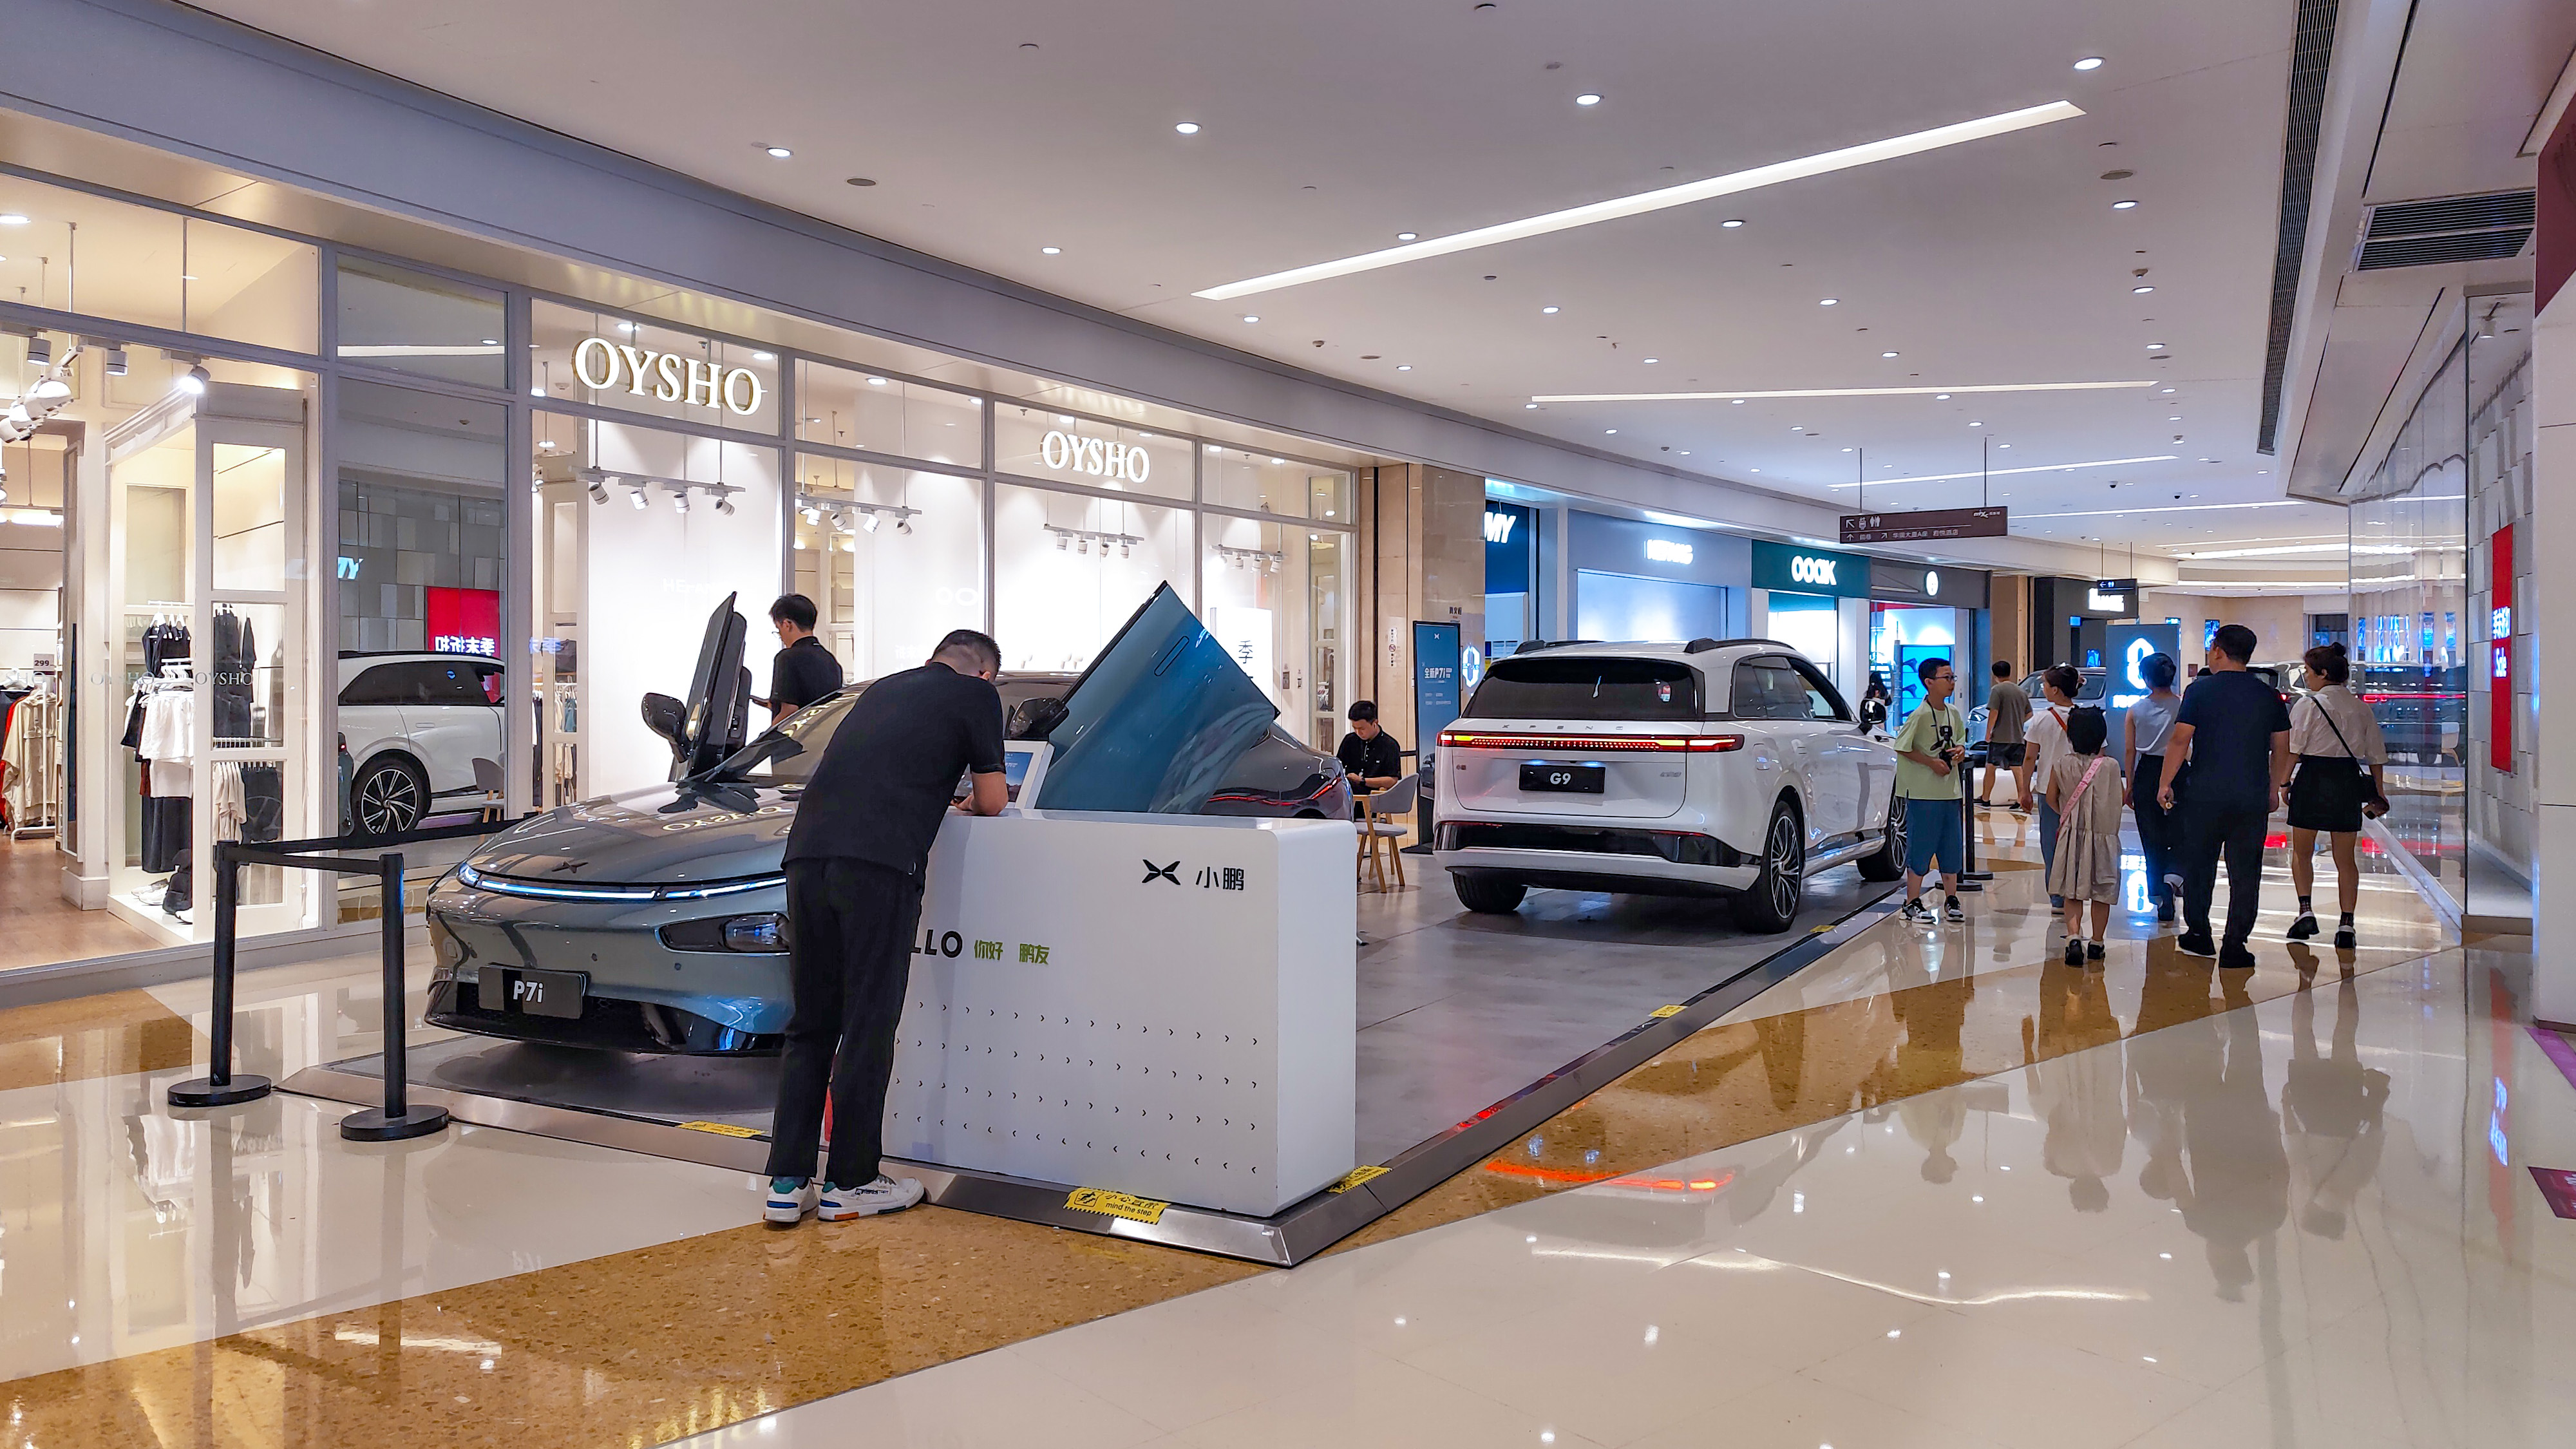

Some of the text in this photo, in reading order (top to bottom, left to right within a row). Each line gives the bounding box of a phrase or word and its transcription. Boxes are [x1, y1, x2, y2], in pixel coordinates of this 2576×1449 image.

[574, 337, 762, 415] OYSHO
[1042, 430, 1151, 483] OYSHO
[194, 671, 254, 685] OYSHO
[1549, 772, 1571, 785] G9
[1195, 866, 1244, 891] 小鹏
[974, 940, 1003, 961] 你好
[1019, 943, 1050, 965] 鹏友
[513, 980, 544, 1003] P7i
[1105, 1202, 1126, 1211] mind
[1137, 1208, 1152, 1217] step
